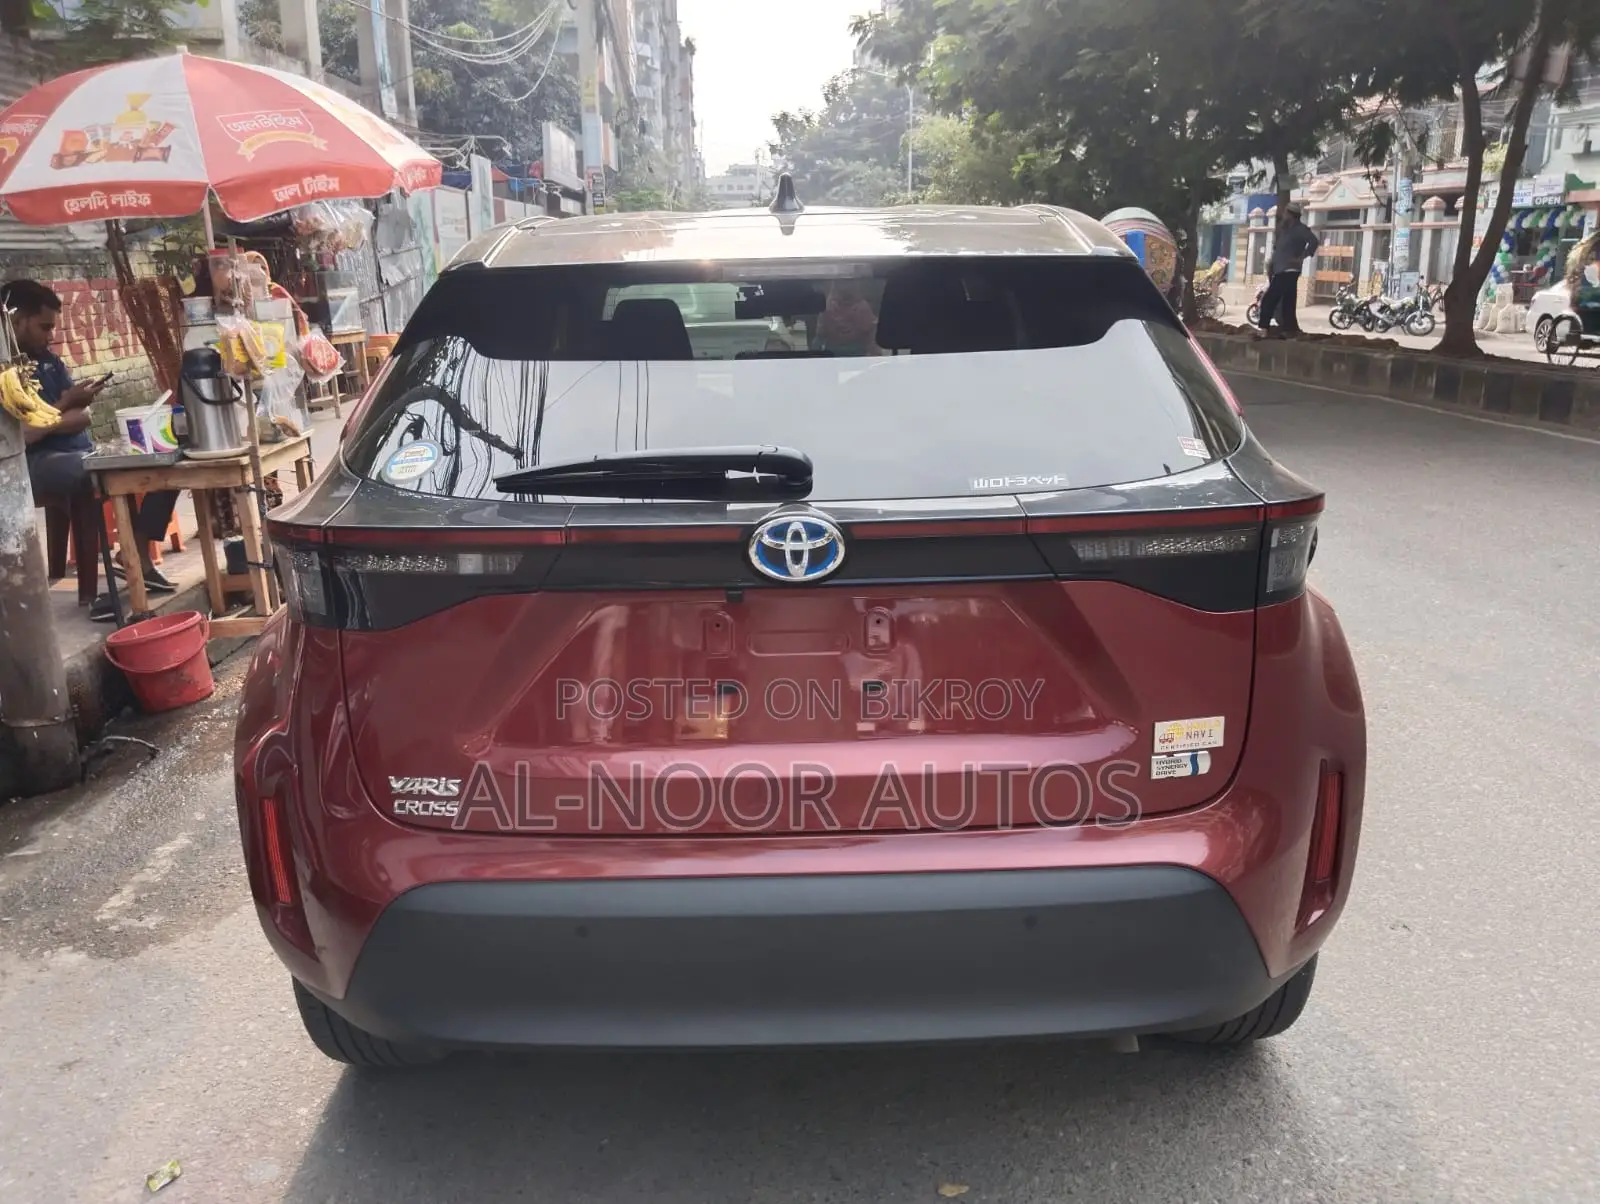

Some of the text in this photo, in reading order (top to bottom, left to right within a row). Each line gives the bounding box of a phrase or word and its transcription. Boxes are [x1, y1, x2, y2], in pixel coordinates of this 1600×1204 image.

[63, 189, 152, 215] হেলদি লাইফ
[1534, 196, 1561, 205] OPEN
[1185, 728, 1214, 740] NAVI
[393, 799, 460, 817] CROSS
